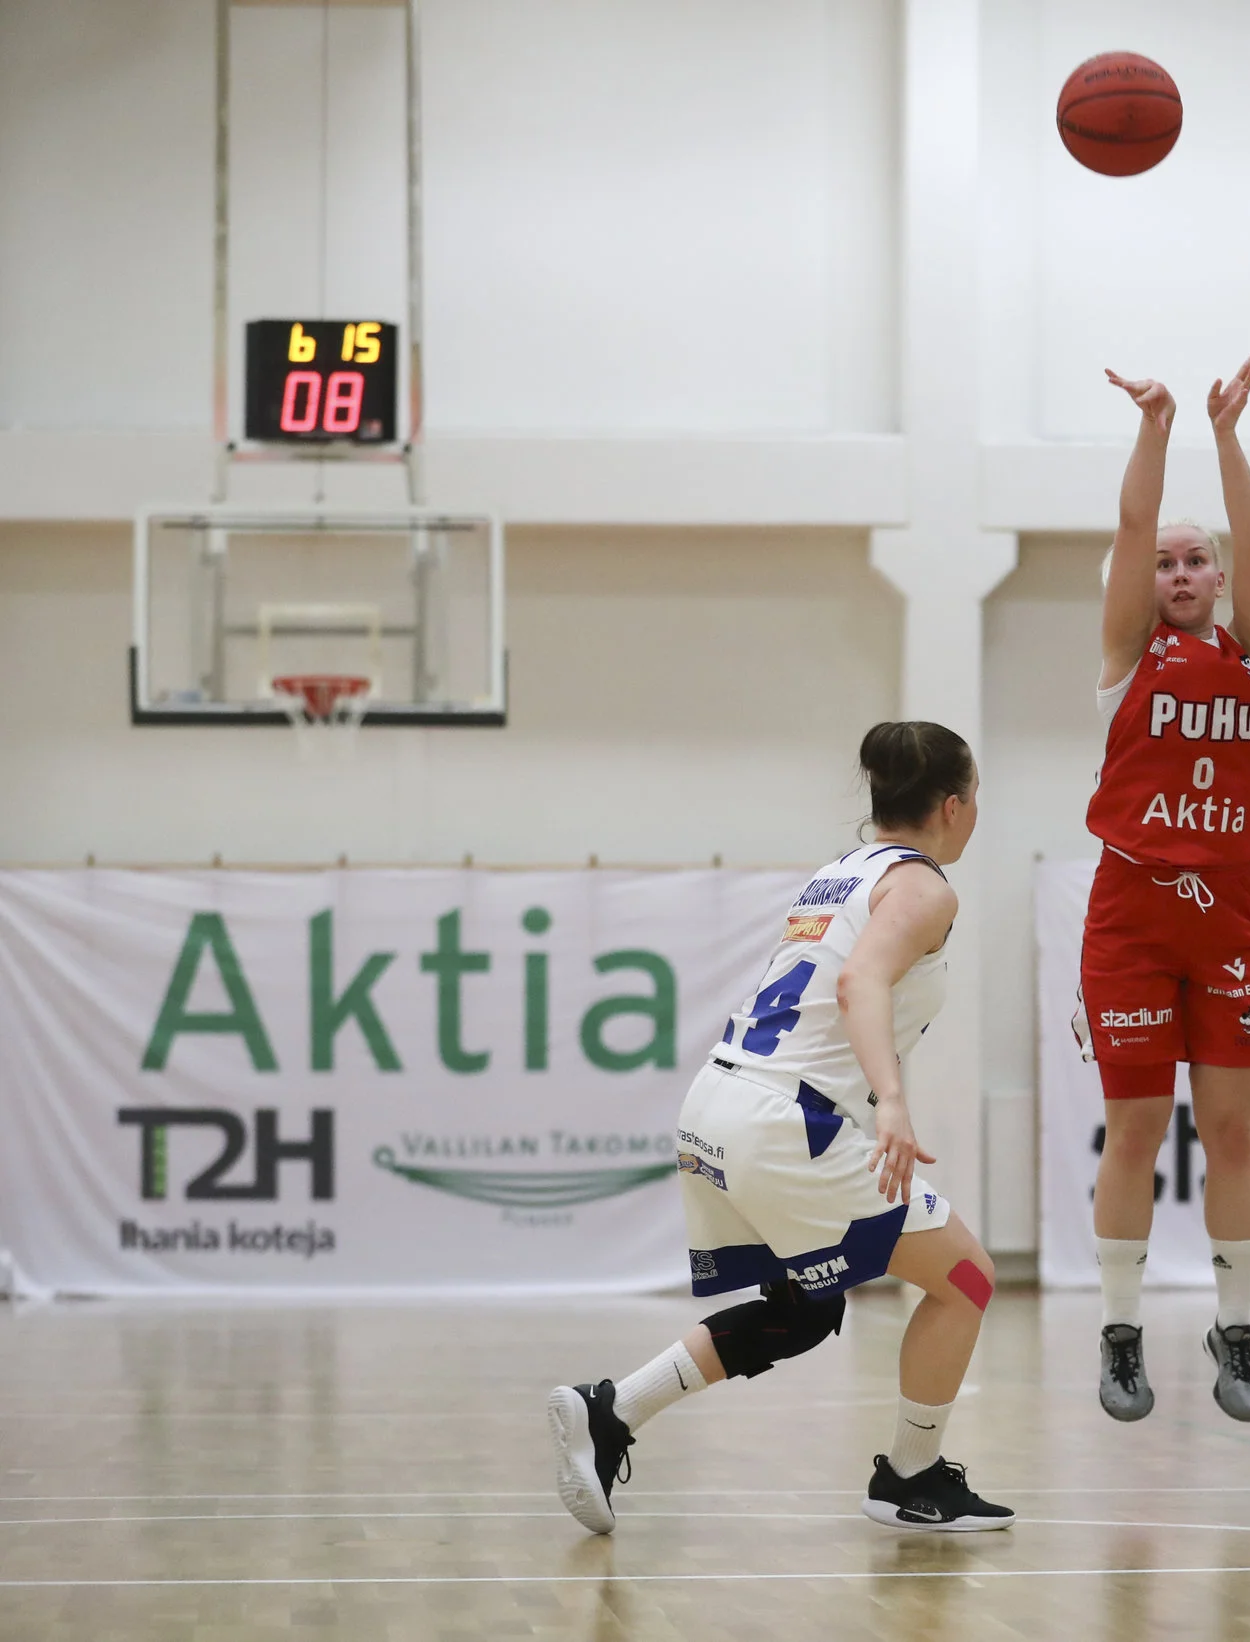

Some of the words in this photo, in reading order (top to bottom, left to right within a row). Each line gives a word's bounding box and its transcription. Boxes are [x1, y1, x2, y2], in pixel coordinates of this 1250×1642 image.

[341, 322, 382, 363] 15
[280, 371, 365, 432] 08
[1141, 792, 1246, 834] Aktia
[140, 906, 678, 1075] Aktia
[1100, 1008, 1173, 1028] stadium
[117, 1108, 336, 1201] T2H
[227, 1219, 336, 1257] koteja
